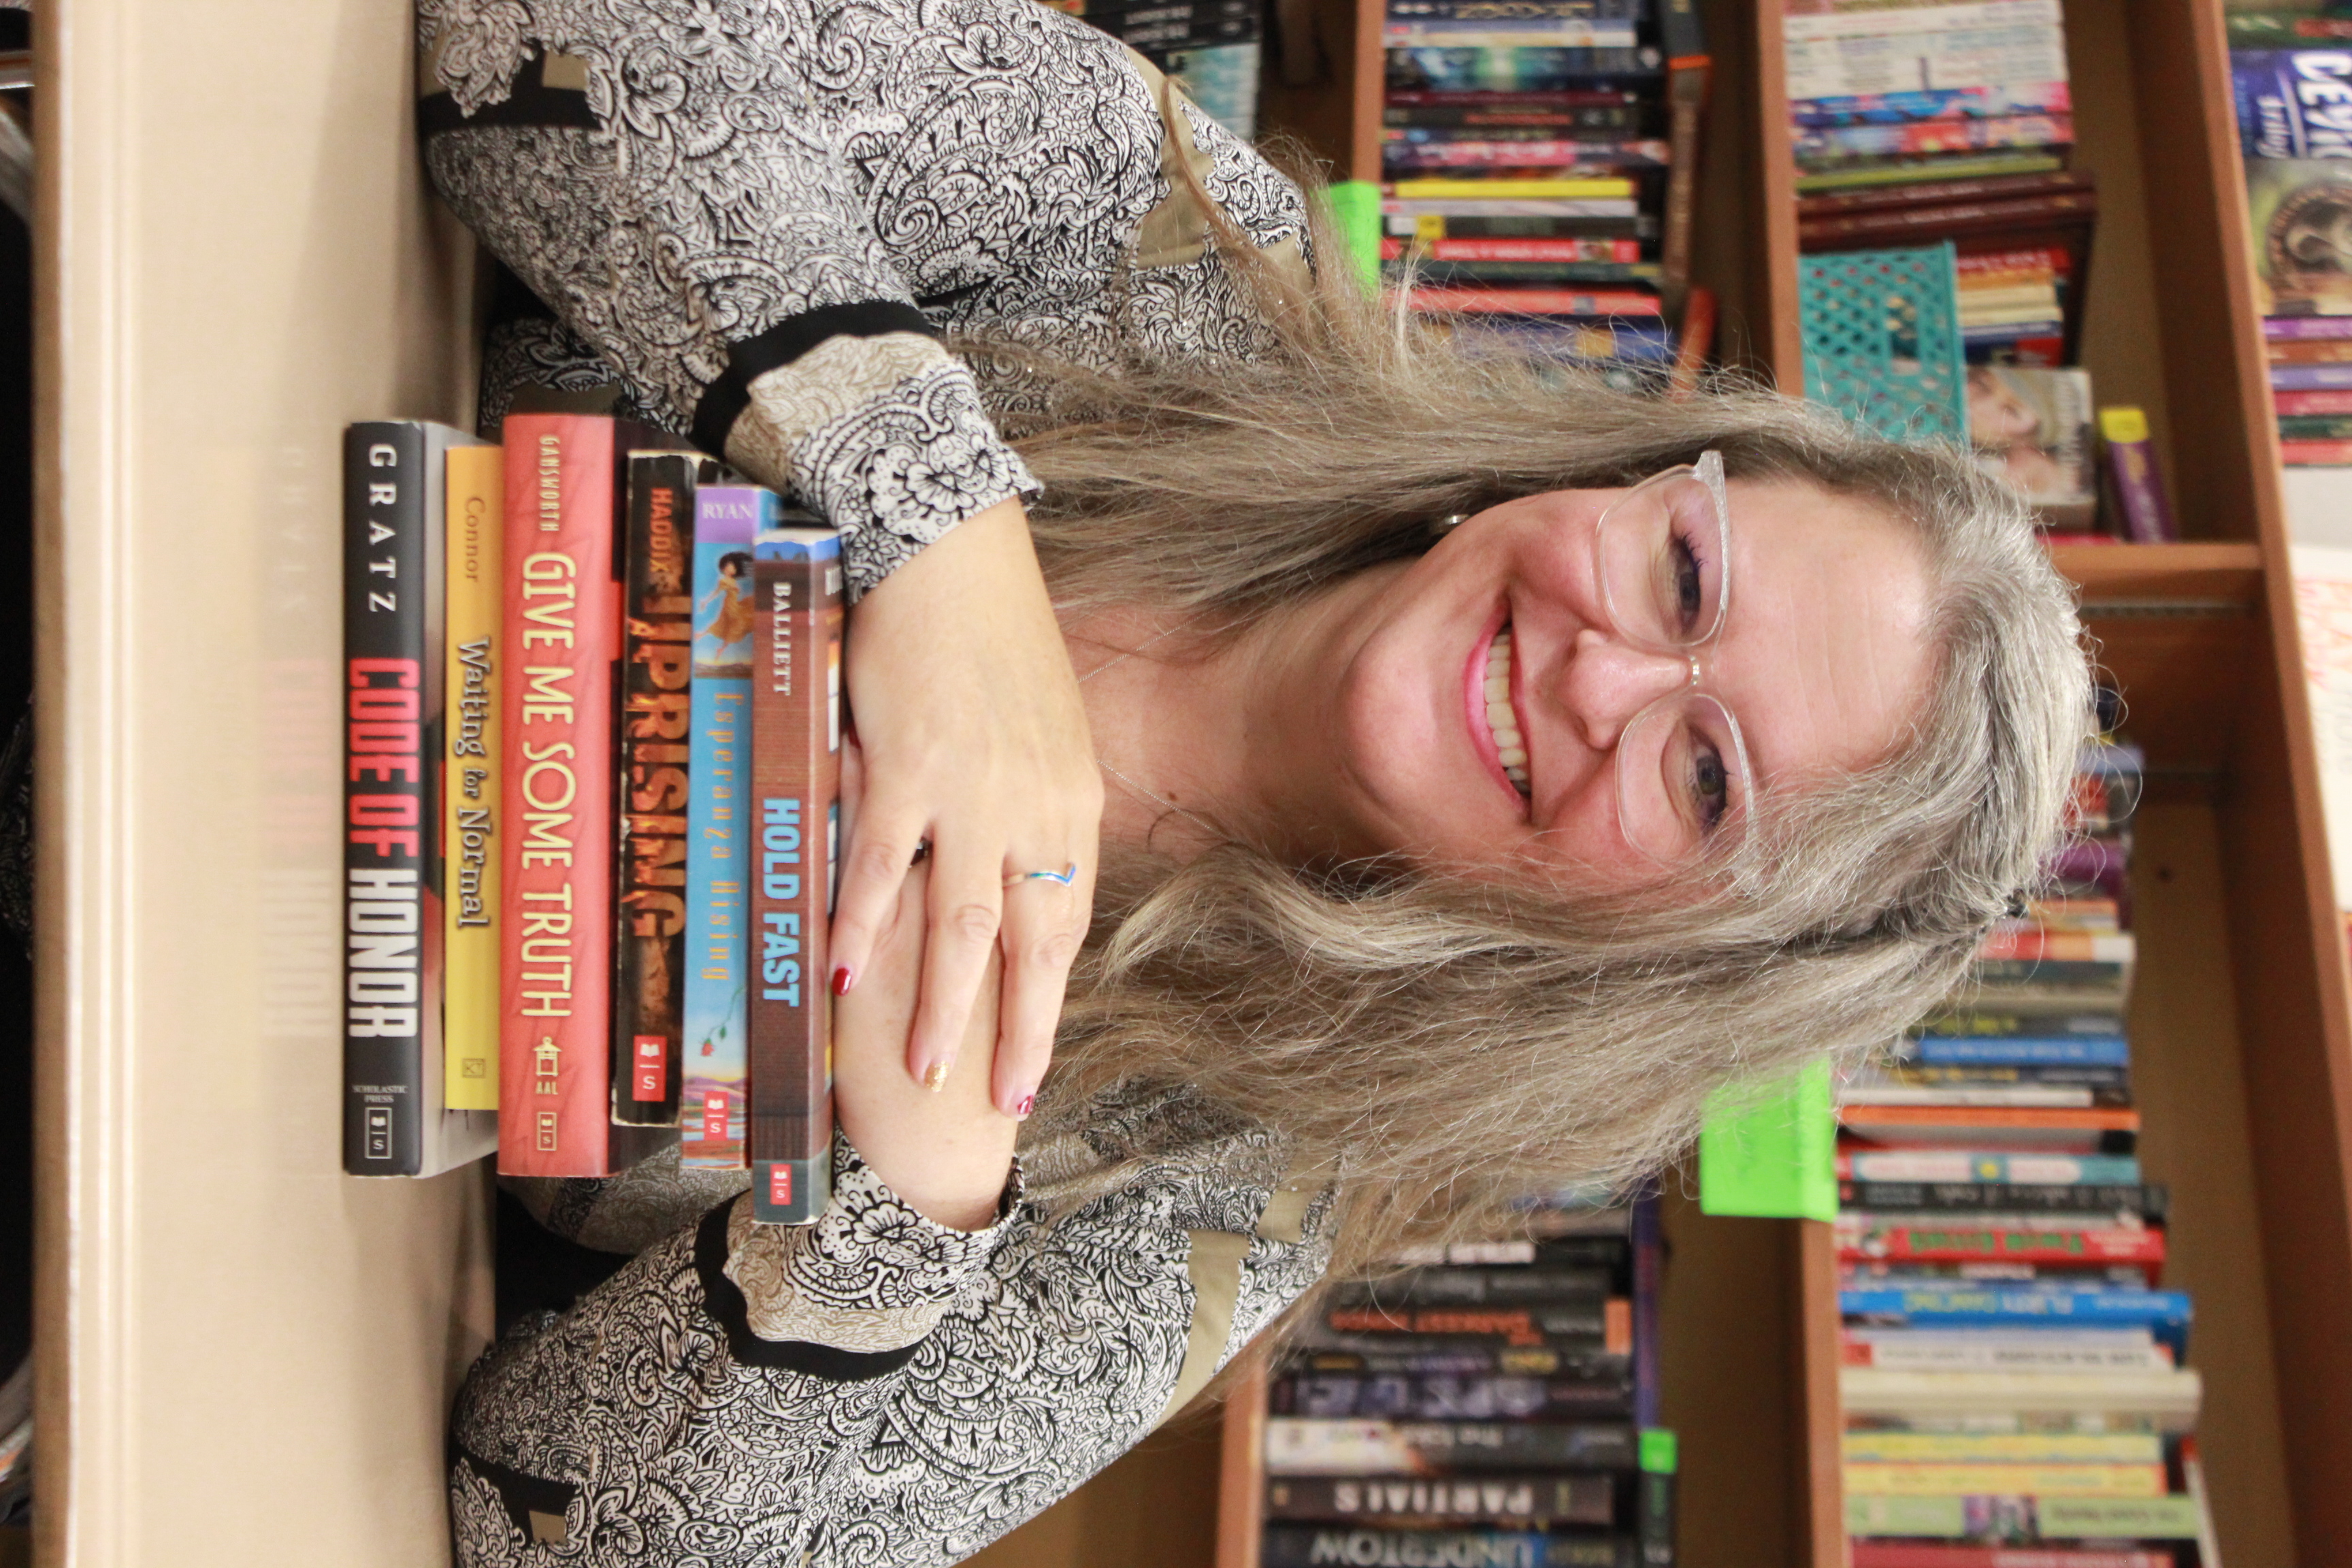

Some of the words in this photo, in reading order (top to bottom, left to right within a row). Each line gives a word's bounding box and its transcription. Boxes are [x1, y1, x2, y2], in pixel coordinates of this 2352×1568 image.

[368, 444, 397, 612] GRATZ
[539, 435, 561, 532] GANSWORTH
[650, 487, 674, 573] HADDIX
[701, 502, 753, 519] RYAN
[465, 496, 485, 583] Connor
[522, 553, 576, 649] GIVE
[772, 582, 792, 697] BALLIETT
[348, 657, 420, 782] CODE
[454, 637, 492, 755] Waiting
[522, 666, 574, 724] ME
[463, 768, 487, 799] for
[521, 742, 576, 869] SOME
[630, 595, 691, 936] UPRISING
[704, 693, 743, 860] Esperanza
[348, 794, 419, 857] OF
[456, 807, 489, 929] Normal
[762, 798, 800, 900] HOLD
[348, 868, 418, 1037] HONOR
[521, 883, 572, 1017] TRUTH
[701, 879, 740, 981] Rising
[762, 913, 800, 1007] FAST
[352, 1085, 408, 1094] SCHOLASTIC
[536, 1081, 558, 1095] AAL
[1335, 1484, 1534, 1515] PARTIALS
